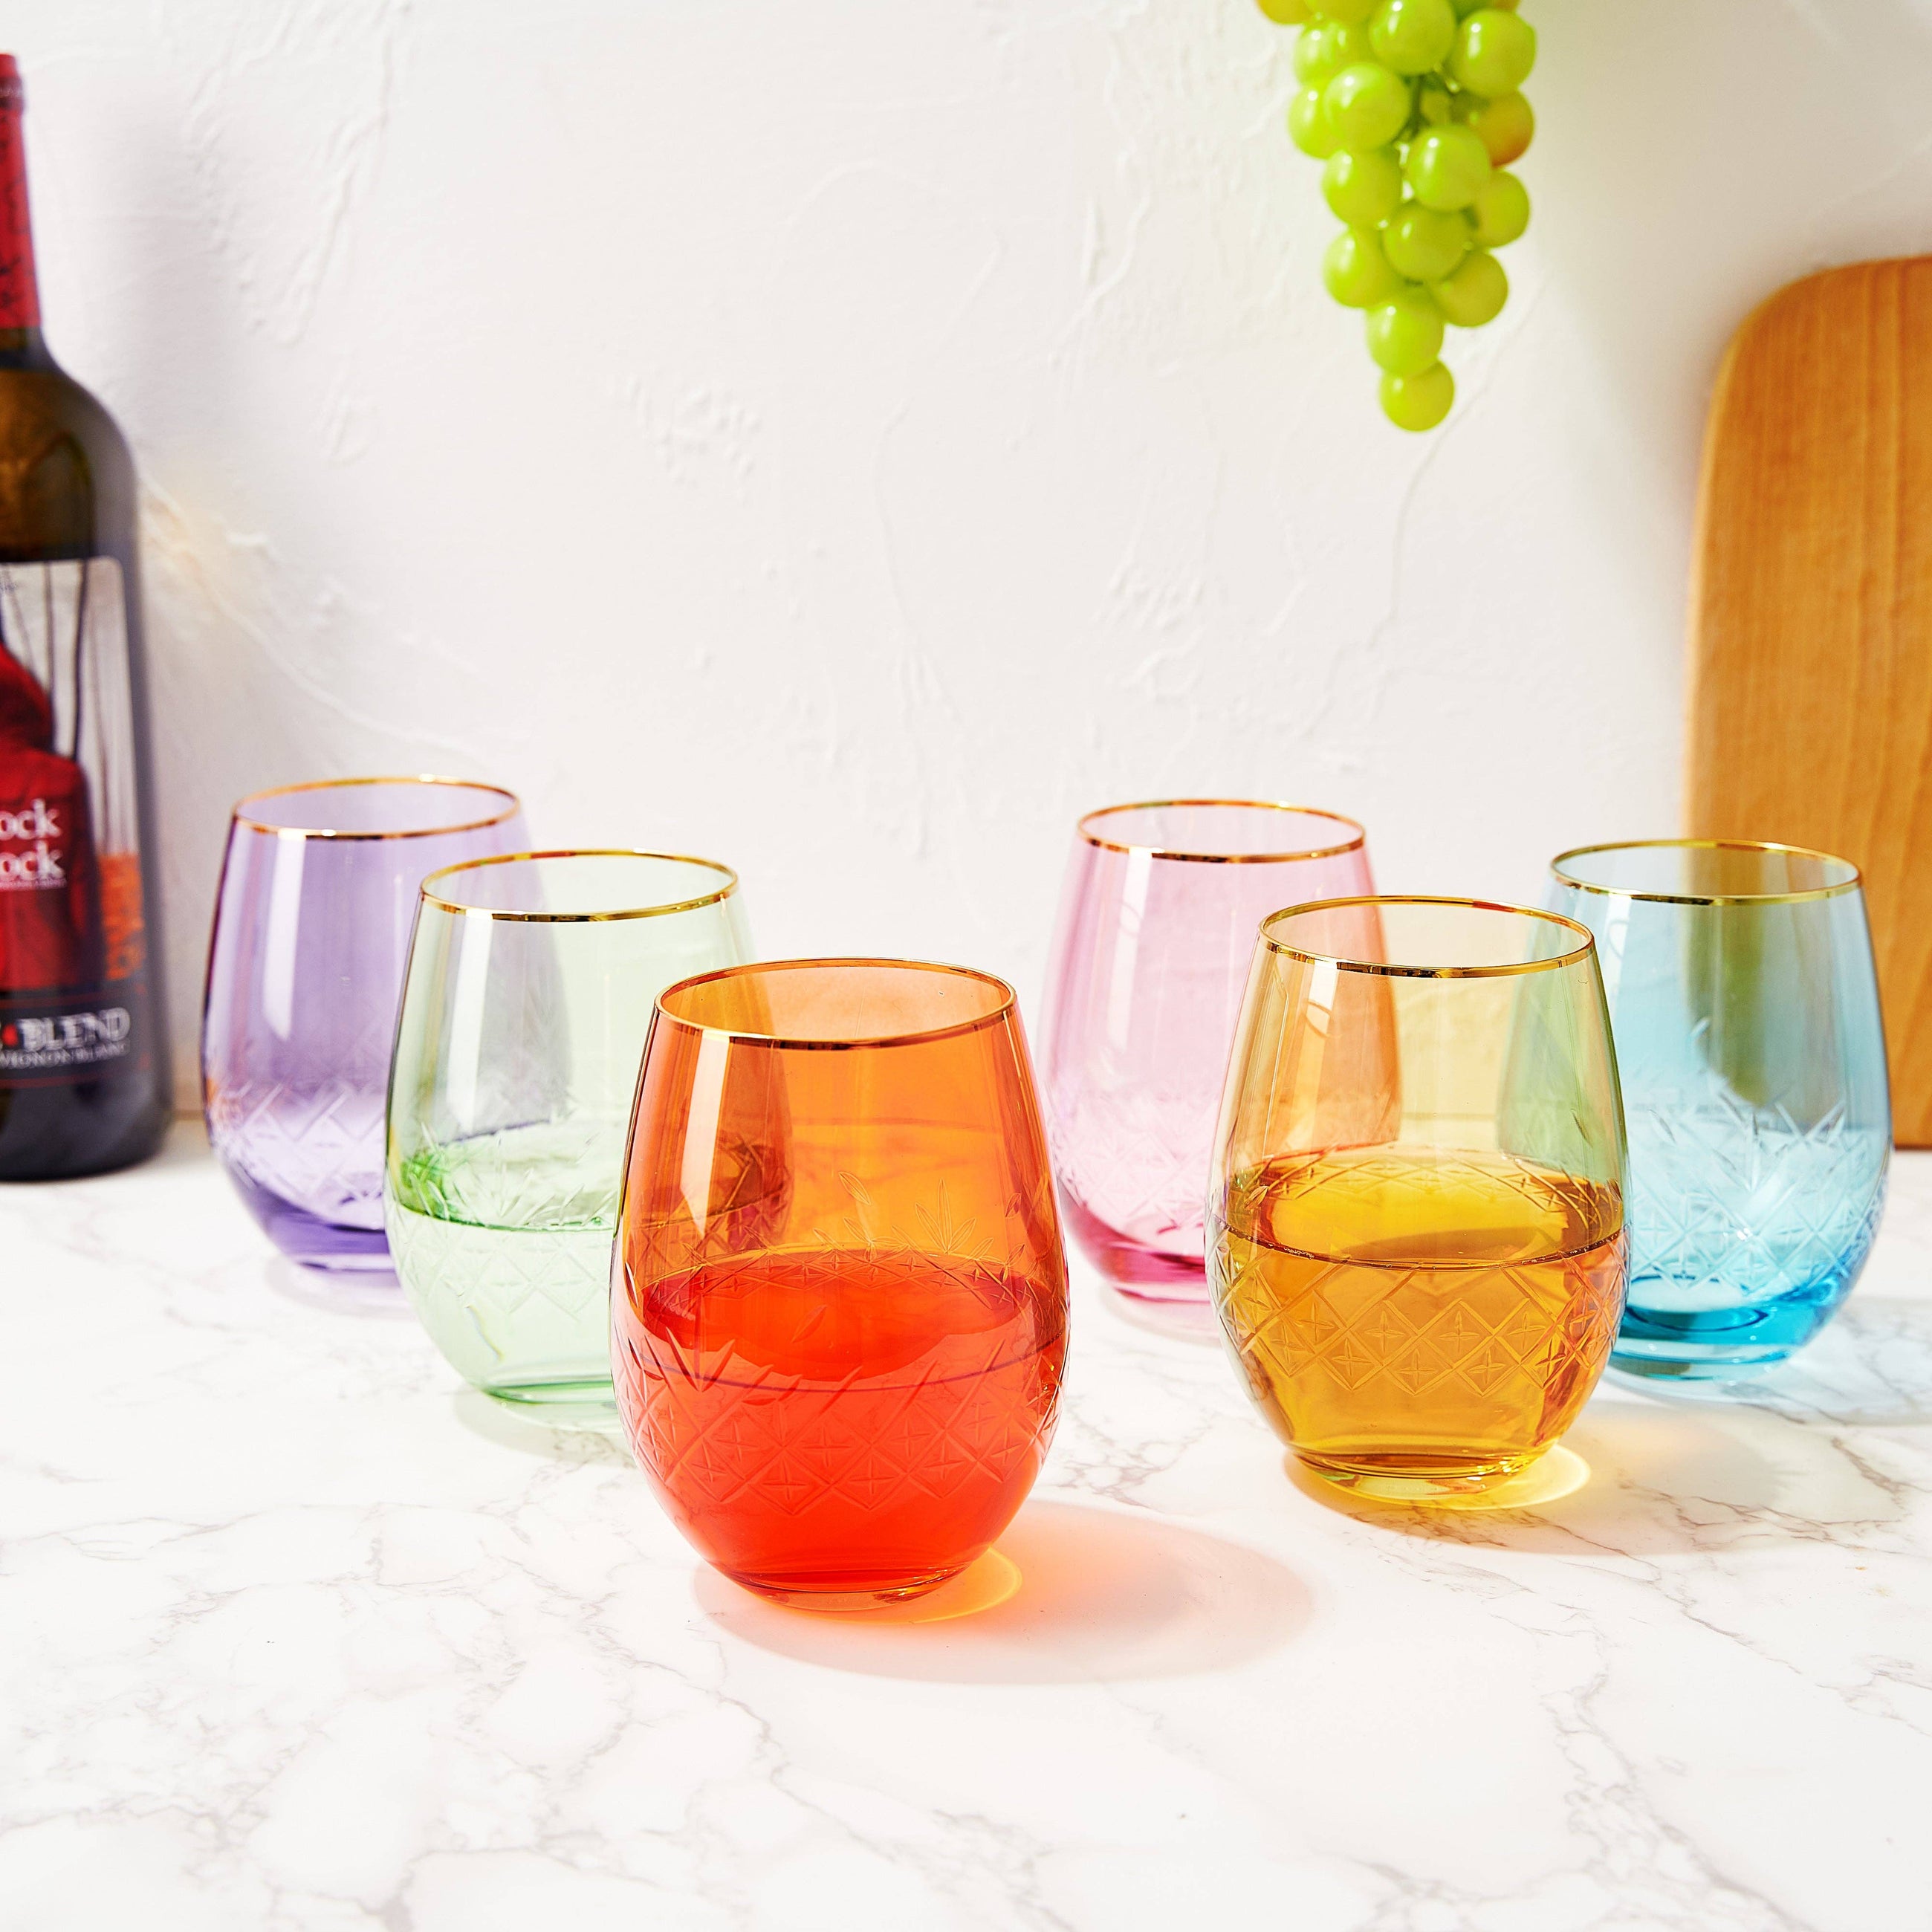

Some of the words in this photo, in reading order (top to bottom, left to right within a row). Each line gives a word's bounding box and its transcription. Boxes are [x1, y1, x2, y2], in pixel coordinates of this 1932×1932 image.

[0, 798, 61, 840] ock
[0, 839, 65, 881] ock
[18, 1007, 130, 1052] BLEND
